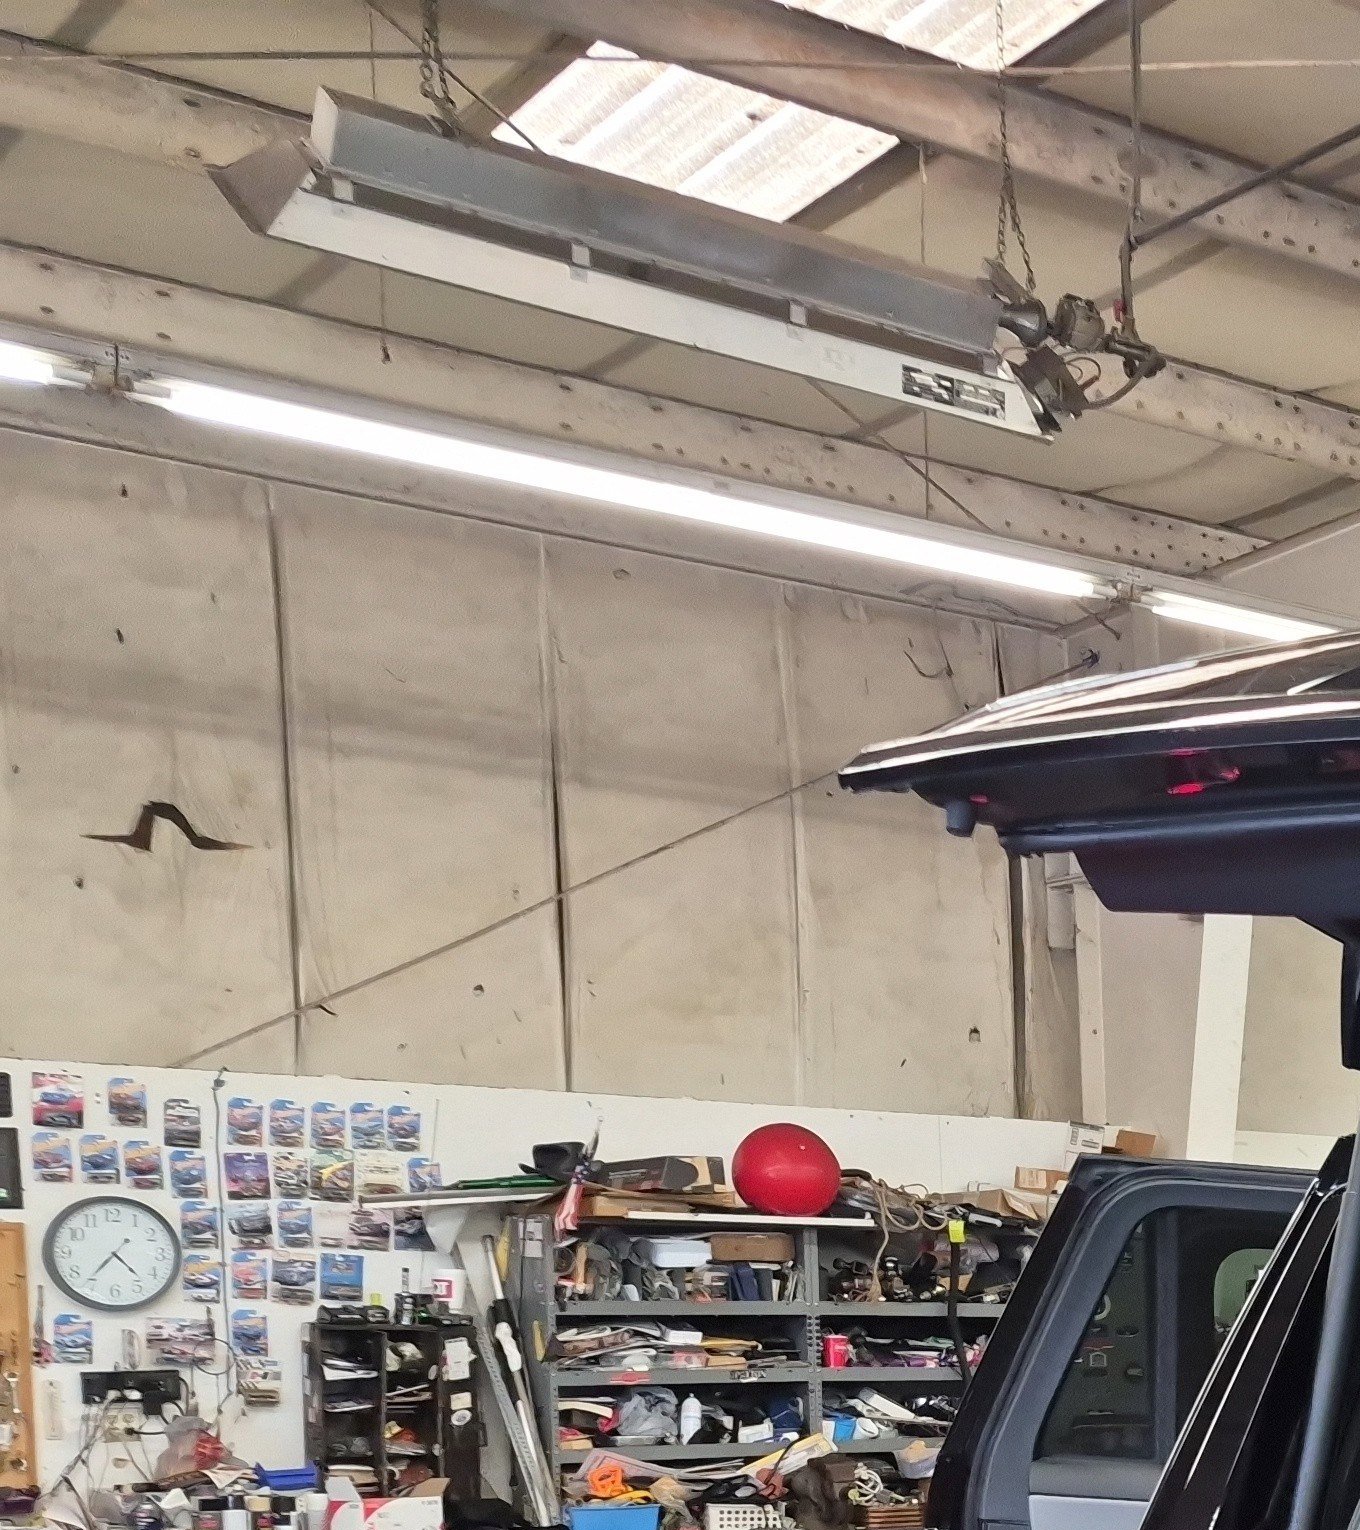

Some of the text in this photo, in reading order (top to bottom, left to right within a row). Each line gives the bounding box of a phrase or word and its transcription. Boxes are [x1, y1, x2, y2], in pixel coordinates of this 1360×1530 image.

[84, 1213, 98, 1228] 11
[104, 1208, 121, 1223] 12
[132, 1213, 138, 1228] 1
[145, 1227, 157, 1242] 2
[155, 1246, 167, 1262] 3
[69, 1264, 80, 1280] 8
[109, 1284, 121, 1298] 6
